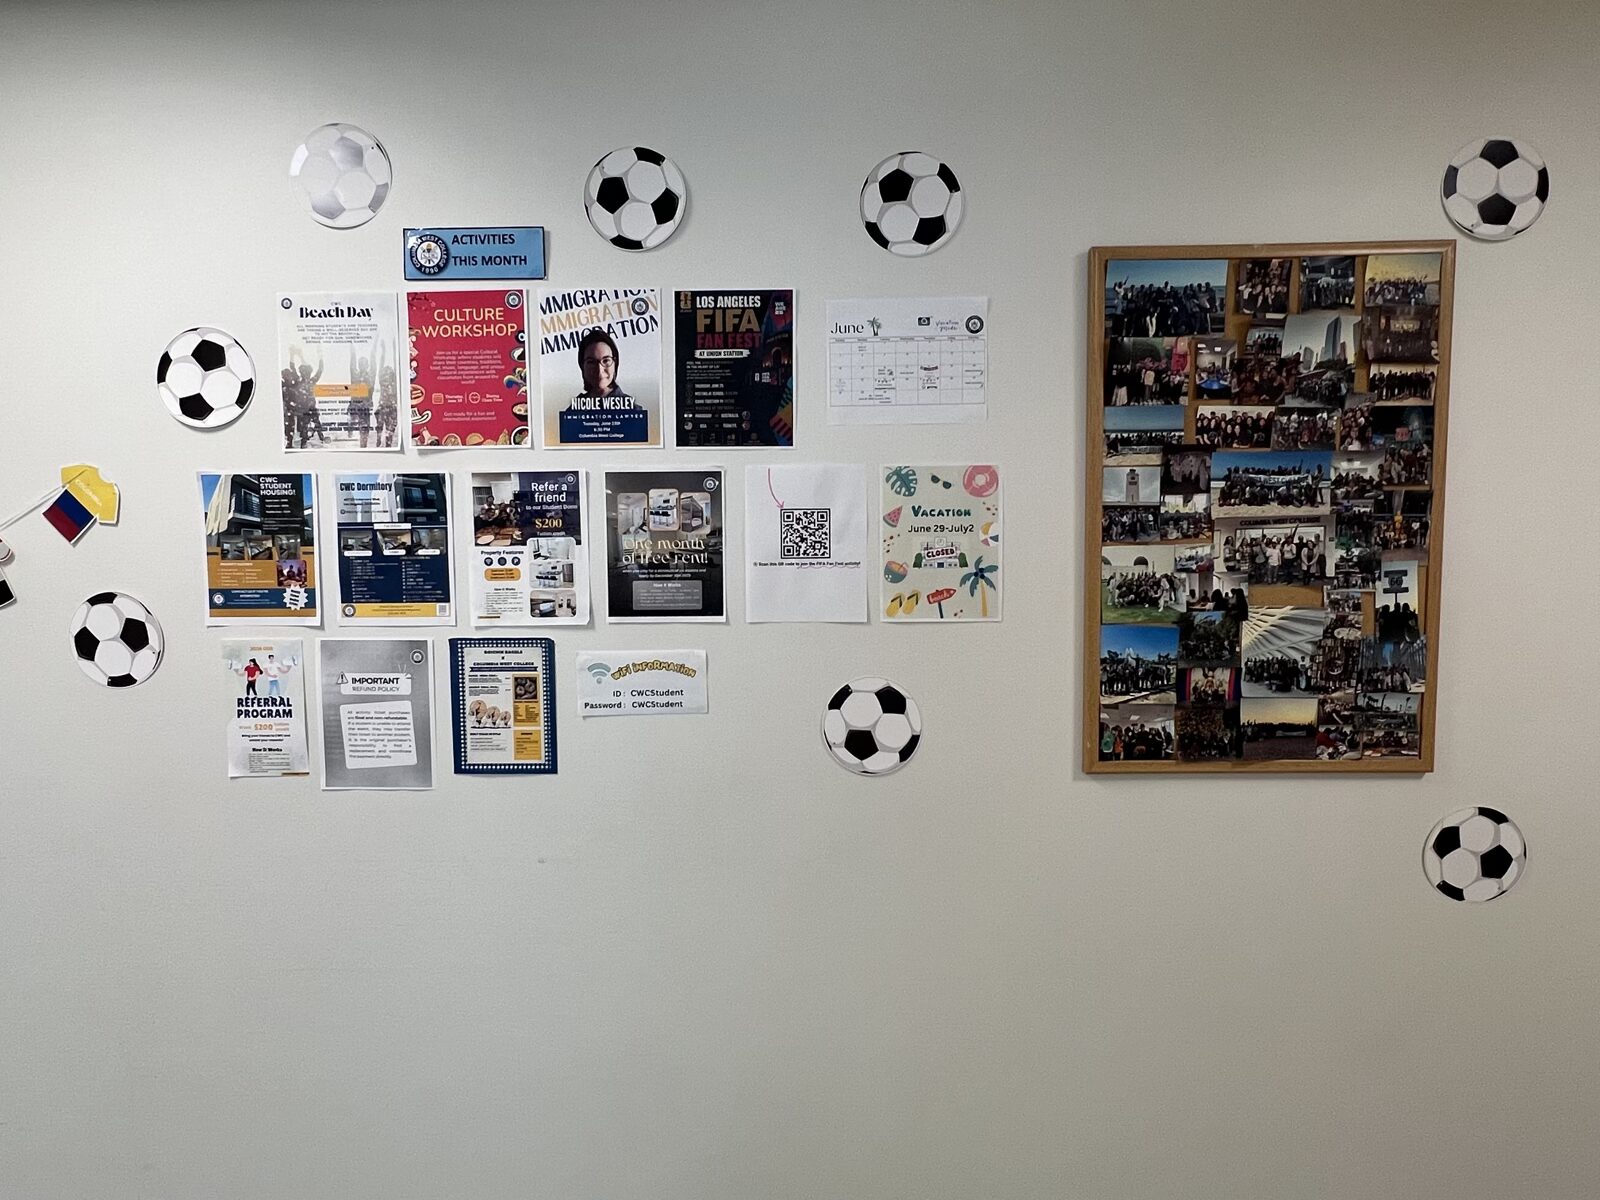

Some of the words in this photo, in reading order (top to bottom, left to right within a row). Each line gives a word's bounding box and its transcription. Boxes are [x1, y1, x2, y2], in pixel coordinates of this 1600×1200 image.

[452, 234, 515, 245] ACTIVITIES
[452, 256, 477, 266] THIS
[481, 255, 527, 265] MONTH
[696, 296, 714, 308] LOS
[717, 296, 761, 307] ANGELES
[300, 307, 344, 318] Beach
[347, 307, 373, 321] Day
[434, 308, 504, 321] CULTURE
[696, 309, 761, 333] FIFA
[422, 324, 518, 338] WORKSHOP
[830, 322, 864, 334] June
[696, 333, 724, 348] FAN
[728, 333, 762, 348] FEST
[571, 397, 600, 410] NICOLE
[603, 397, 635, 410] WESLEY
[340, 483, 355, 491] CWC
[357, 482, 392, 491] Dormitory
[531, 482, 558, 491] Refer
[561, 483, 567, 491] a
[535, 492, 566, 502] friend
[535, 518, 562, 528] $200
[908, 525, 931, 533] June
[624, 538, 653, 549] One
[658, 538, 705, 550] month
[623, 552, 635, 564] of
[926, 548, 955, 558] CLOSED
[630, 689, 684, 697] CWCStudent
[237, 697, 292, 707] REFERRAL
[237, 709, 292, 718] PROGRAM
